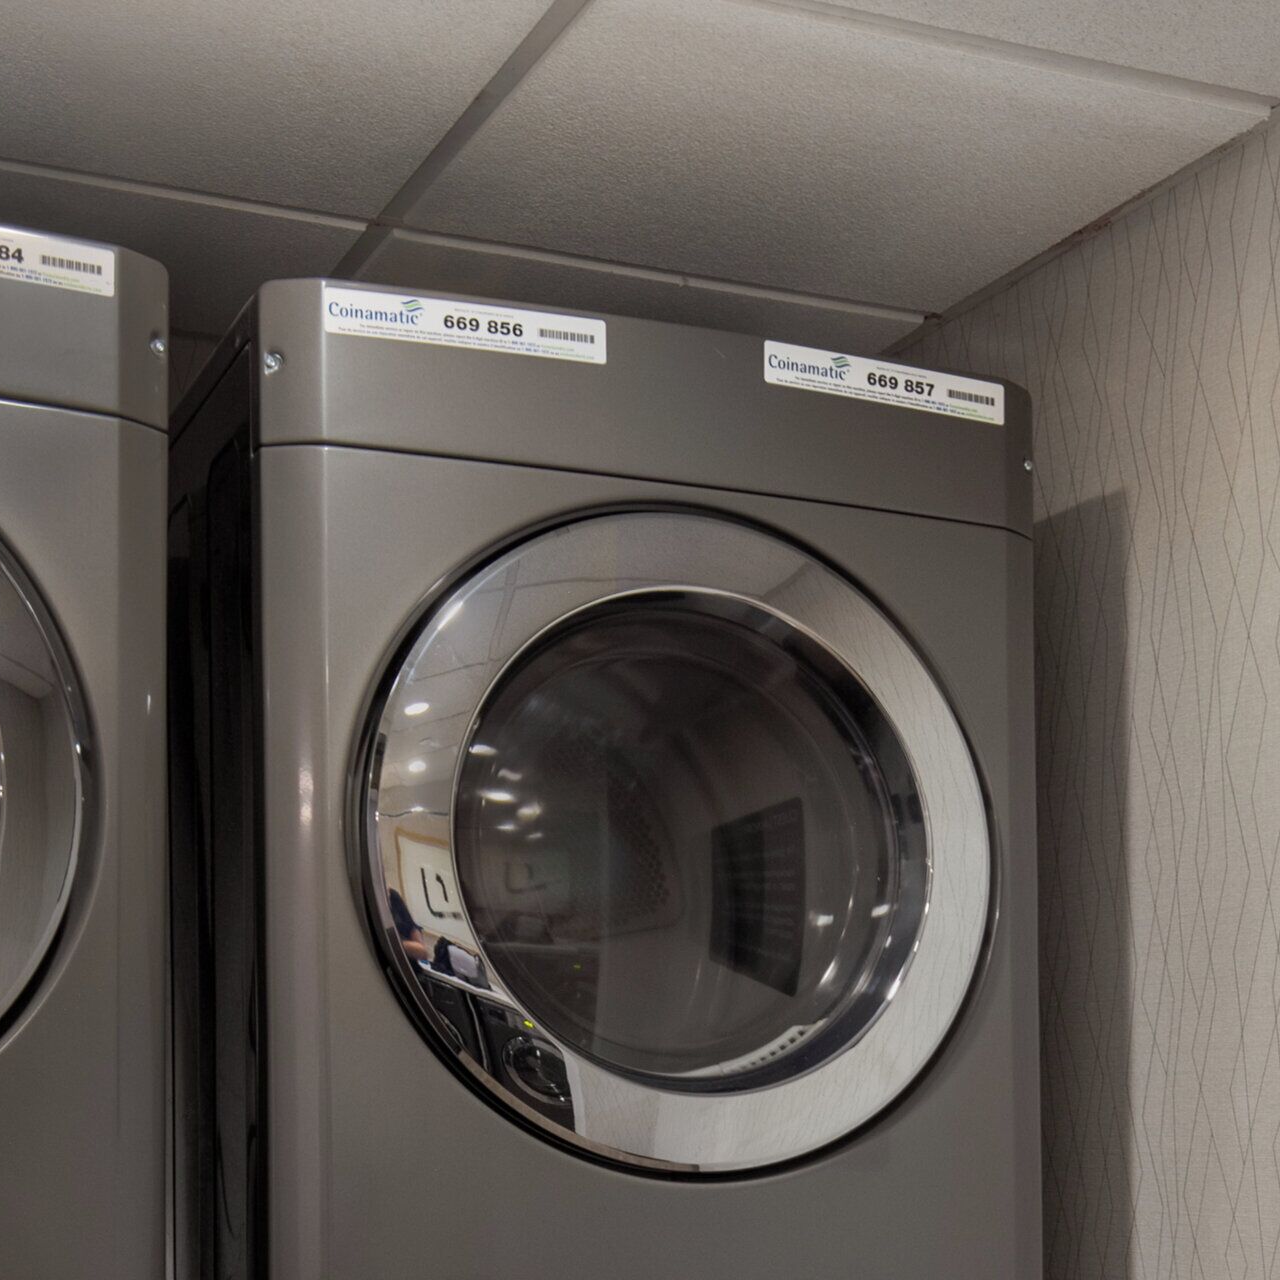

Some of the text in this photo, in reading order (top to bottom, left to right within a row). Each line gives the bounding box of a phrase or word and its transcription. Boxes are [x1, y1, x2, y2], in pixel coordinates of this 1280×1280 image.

[328, 301, 419, 326] Coinamatic
[443, 314, 524, 338] 669 856
[768, 353, 847, 381] Coinamatic
[867, 372, 935, 397] 669 857
